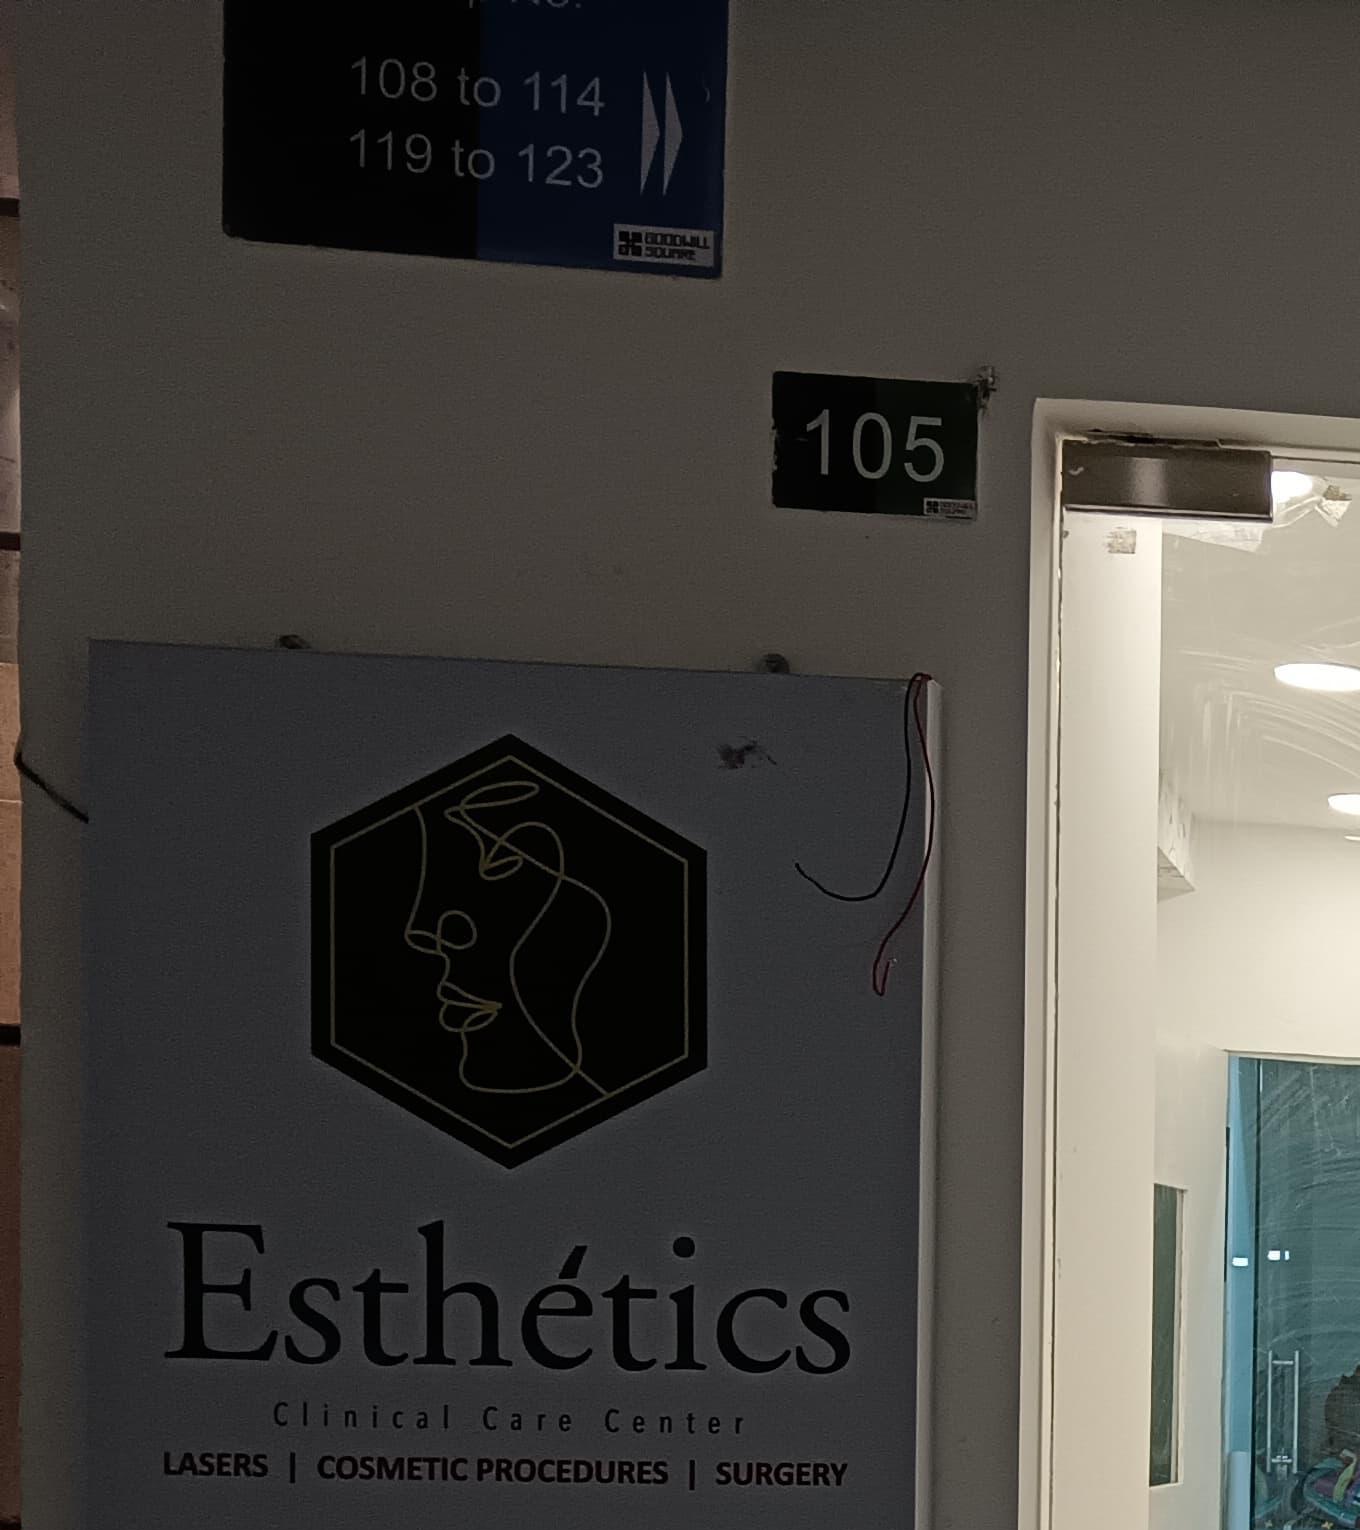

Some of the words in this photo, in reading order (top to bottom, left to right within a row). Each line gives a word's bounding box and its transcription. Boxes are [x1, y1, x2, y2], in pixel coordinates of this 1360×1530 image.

[352, 57, 437, 101] 108
[458, 68, 501, 107] to
[525, 72, 604, 116] 114
[350, 129, 432, 173] 119
[452, 140, 495, 179] to
[519, 144, 603, 188] 123
[807, 409, 944, 482] 105
[164, 1220, 850, 1374] Esthétics
[274, 1402, 448, 1429] Clinical
[483, 1406, 571, 1431] Care
[605, 1409, 743, 1434] Center
[164, 1452, 268, 1477] LASERS
[318, 1456, 467, 1481] COSMETIC
[477, 1458, 668, 1484] PROCEDURES
[716, 1462, 847, 1486] SURGERY
